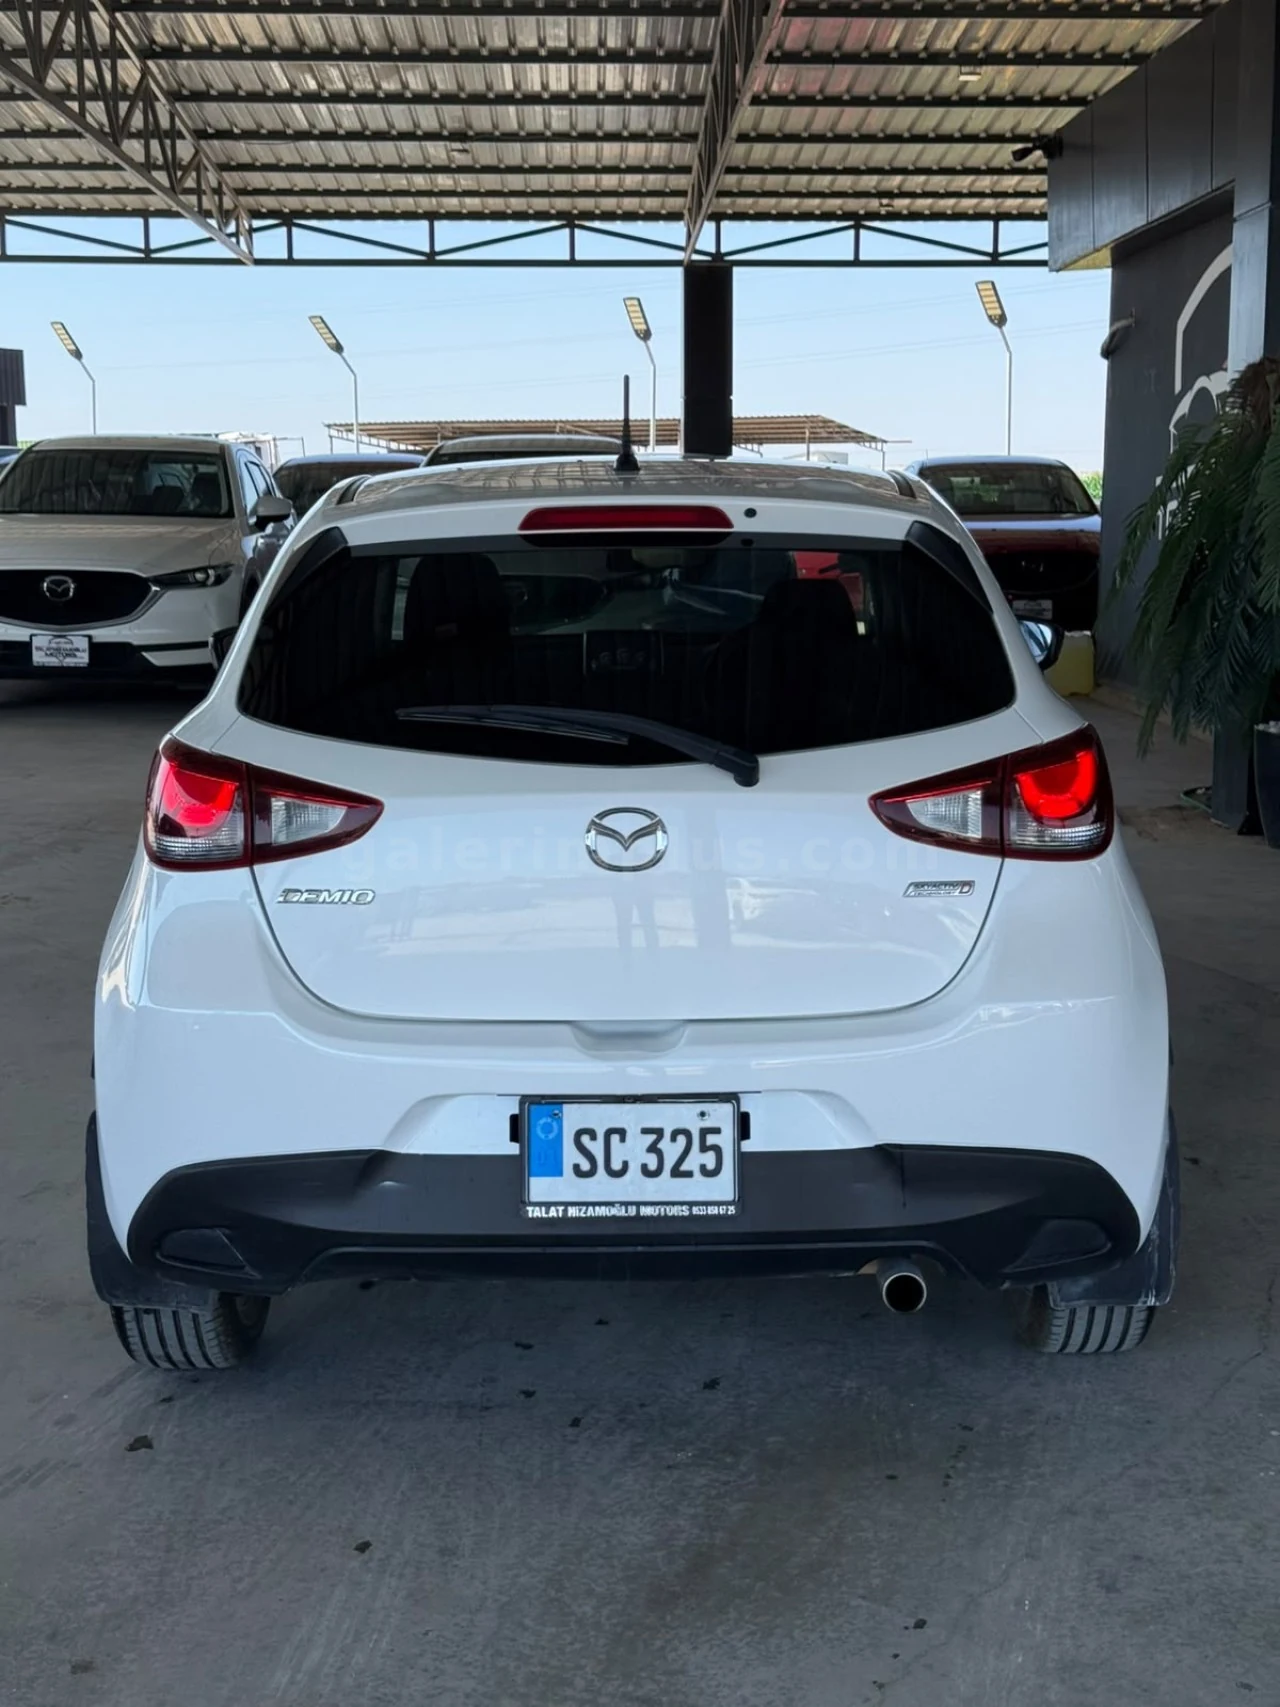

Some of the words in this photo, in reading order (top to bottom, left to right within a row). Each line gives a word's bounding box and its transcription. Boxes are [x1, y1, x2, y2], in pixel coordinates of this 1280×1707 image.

[277, 888, 375, 905] DEMIO
[572, 1127, 629, 1178] SC
[640, 1127, 723, 1178] 325
[526, 1206, 564, 1218] TALAT
[639, 1205, 690, 1217] MOTORS
